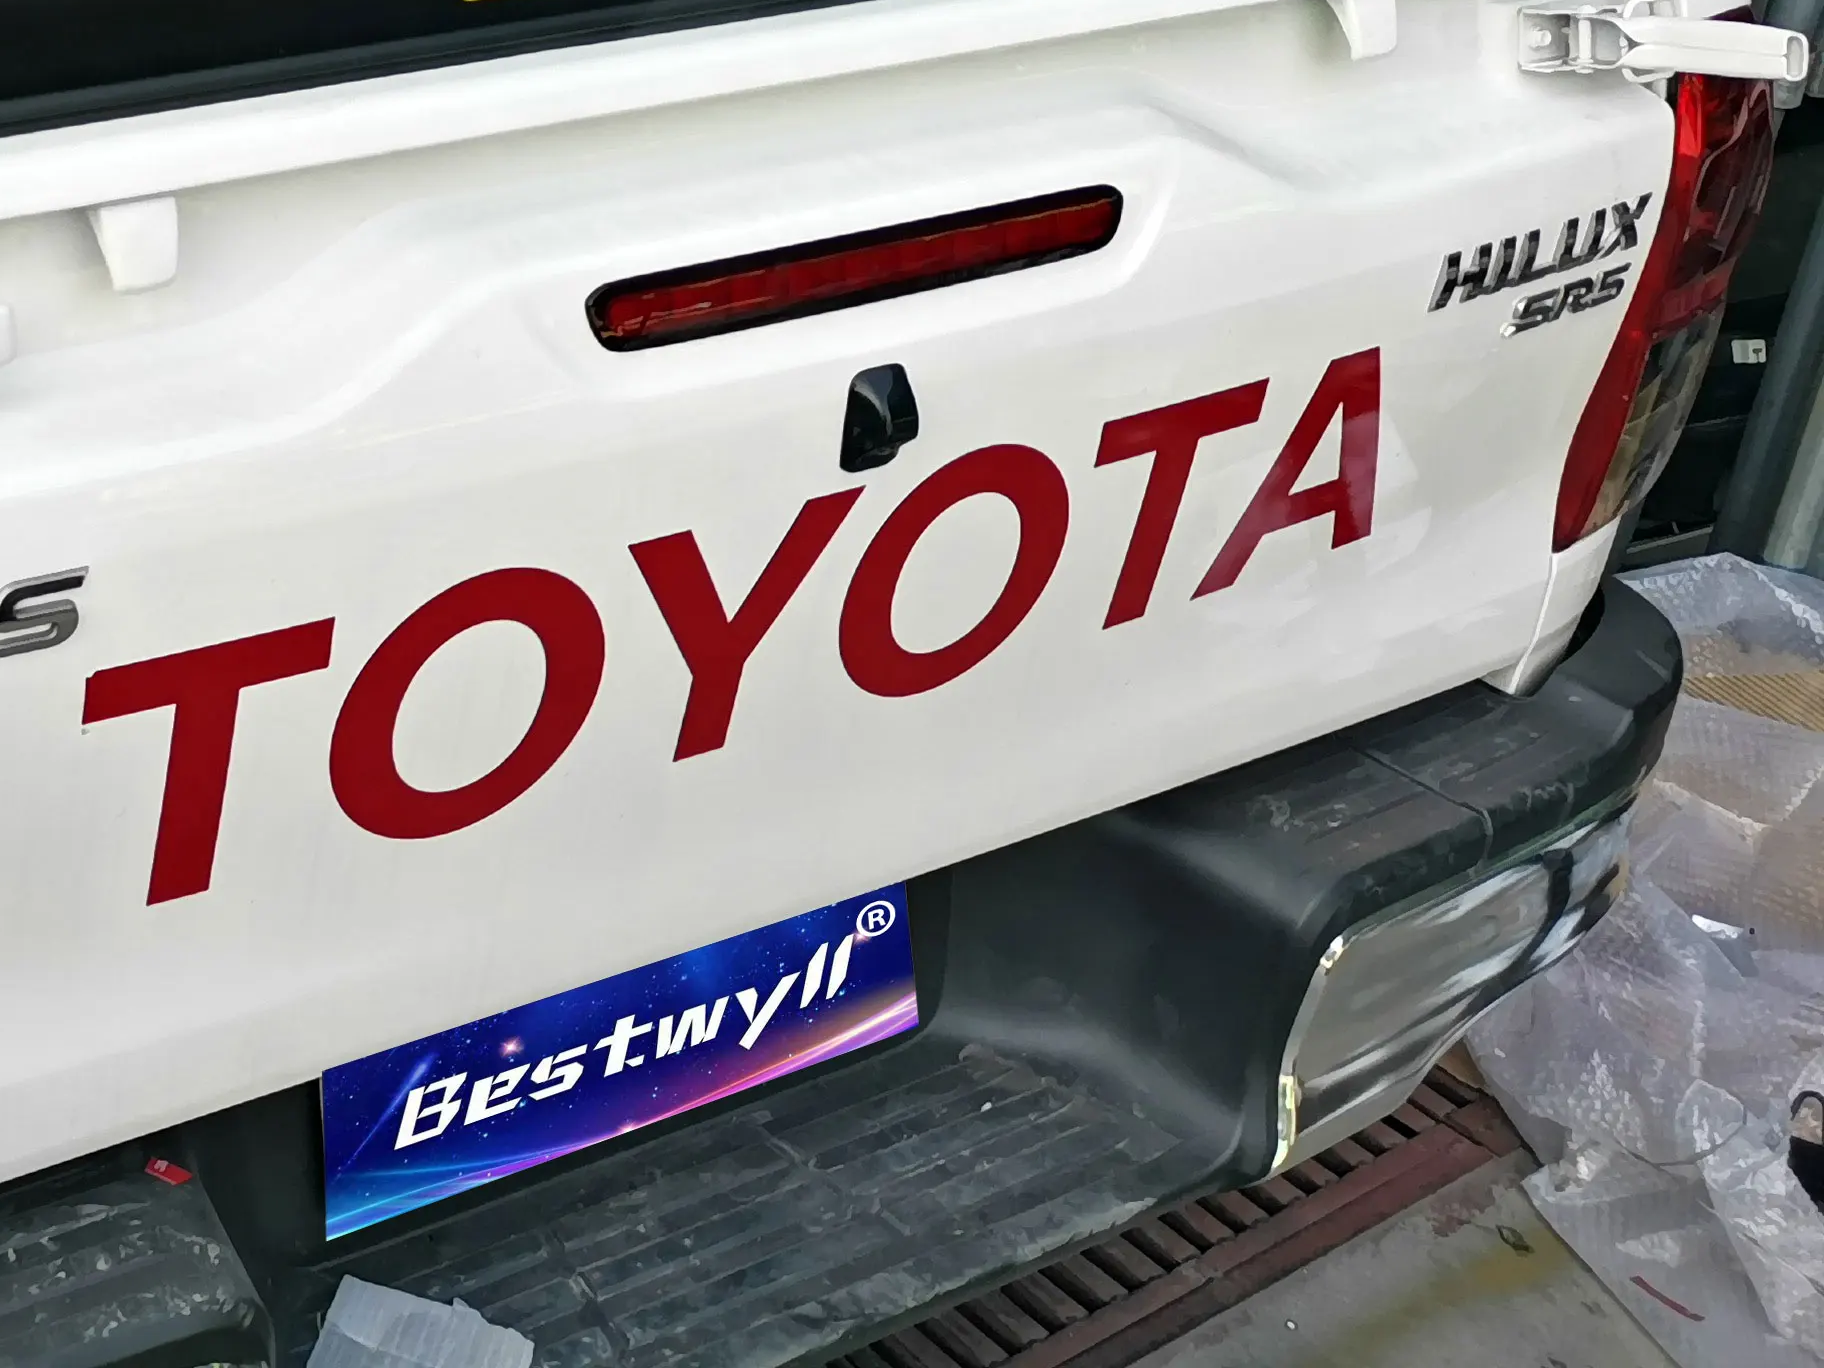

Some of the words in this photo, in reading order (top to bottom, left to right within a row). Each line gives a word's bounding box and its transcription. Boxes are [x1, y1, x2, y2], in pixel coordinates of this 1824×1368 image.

[1427, 191, 1653, 312] HILUX
[1499, 262, 1632, 339] SR5
[83, 347, 1382, 907] TOYOTA
